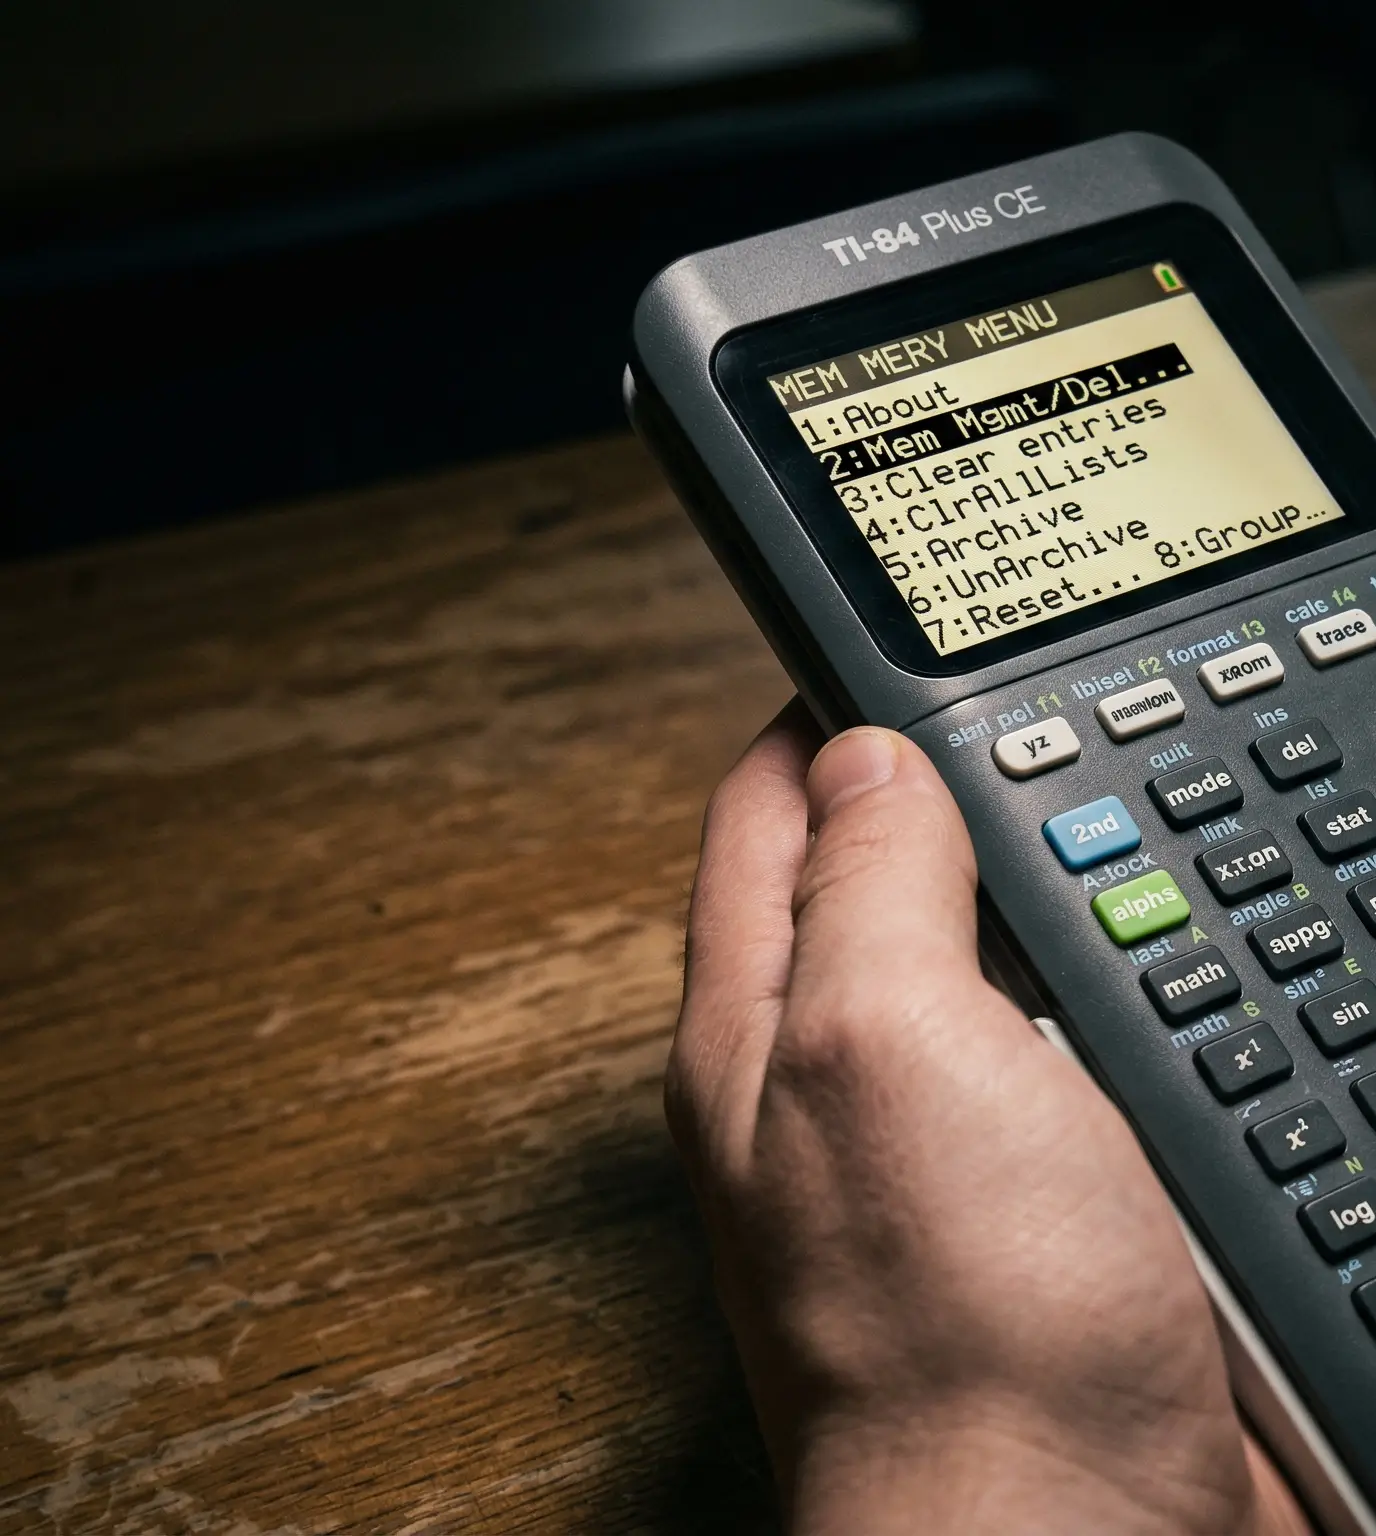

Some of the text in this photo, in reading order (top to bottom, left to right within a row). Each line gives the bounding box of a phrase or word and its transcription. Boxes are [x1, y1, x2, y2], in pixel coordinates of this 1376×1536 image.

[822, 185, 1047, 267] TI-84 Plus CE
[769, 299, 1058, 406] MEM MERY MENU
[800, 381, 960, 446] 1:About
[819, 362, 1188, 482] 2:Mem Mgmt/Del...
[840, 398, 1167, 514] 3:Clear entries
[866, 442, 1149, 546] 4:ClrAllLists
[879, 500, 1084, 582] 5:Archive
[907, 519, 1150, 615] 6:UnArchive
[923, 573, 1141, 649] 7:Reset...
[1166, 628, 1240, 667] format
[1316, 620, 1368, 647] trace
[1252, 707, 1290, 730] ins
[1149, 740, 1194, 771] quit
[1280, 733, 1319, 762] del
[1165, 771, 1232, 807] mode
[1071, 812, 1120, 845] 2nd
[1199, 814, 1244, 844] link
[1326, 806, 1373, 836] stat
[1229, 882, 1310, 927] angle B
[1127, 926, 1209, 967] last A
[1162, 961, 1228, 1000] math
[1344, 957, 1362, 976] E
[1169, 1013, 1231, 1050] math
[1332, 1000, 1371, 1027] sin
[1344, 1156, 1364, 1175] N
[1329, 1200, 1376, 1231] log
